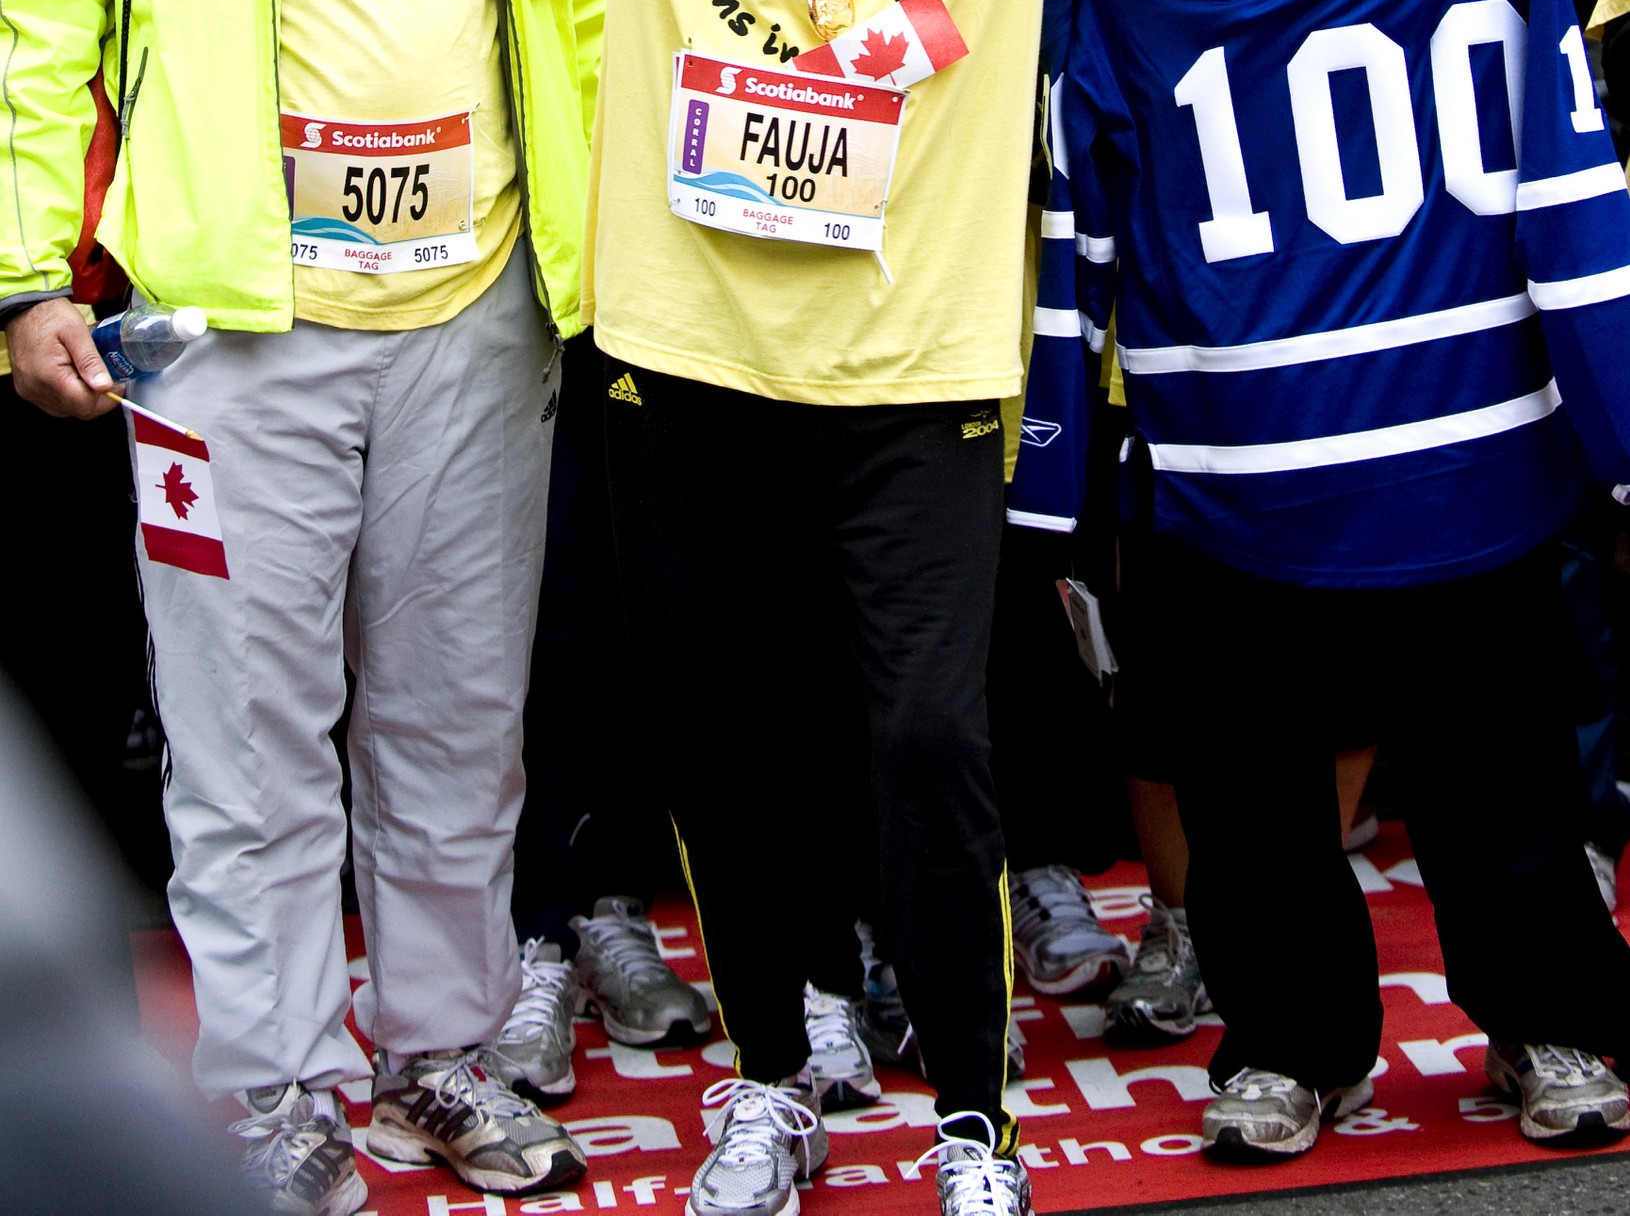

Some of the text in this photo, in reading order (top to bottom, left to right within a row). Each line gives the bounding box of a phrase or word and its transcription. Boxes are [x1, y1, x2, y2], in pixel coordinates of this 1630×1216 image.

[745, 77, 857, 110] Scotiabank
[331, 128, 436, 149] Scotiabank
[689, 107, 703, 167] CORRAL
[740, 112, 848, 177] FAUJA
[341, 164, 431, 225] 5075
[766, 173, 817, 203] 100
[694, 197, 717, 217] 100
[742, 208, 794, 225] BAGGAGE
[755, 221, 778, 234] TAG
[824, 222, 851, 241] 100
[291, 243, 318, 260] 075
[344, 248, 393, 262] BAGGAGE
[414, 244, 449, 263] 5075
[358, 261, 380, 271] TAG
[608, 387, 643, 406] adidas
[962, 419, 999, 439] 2004
